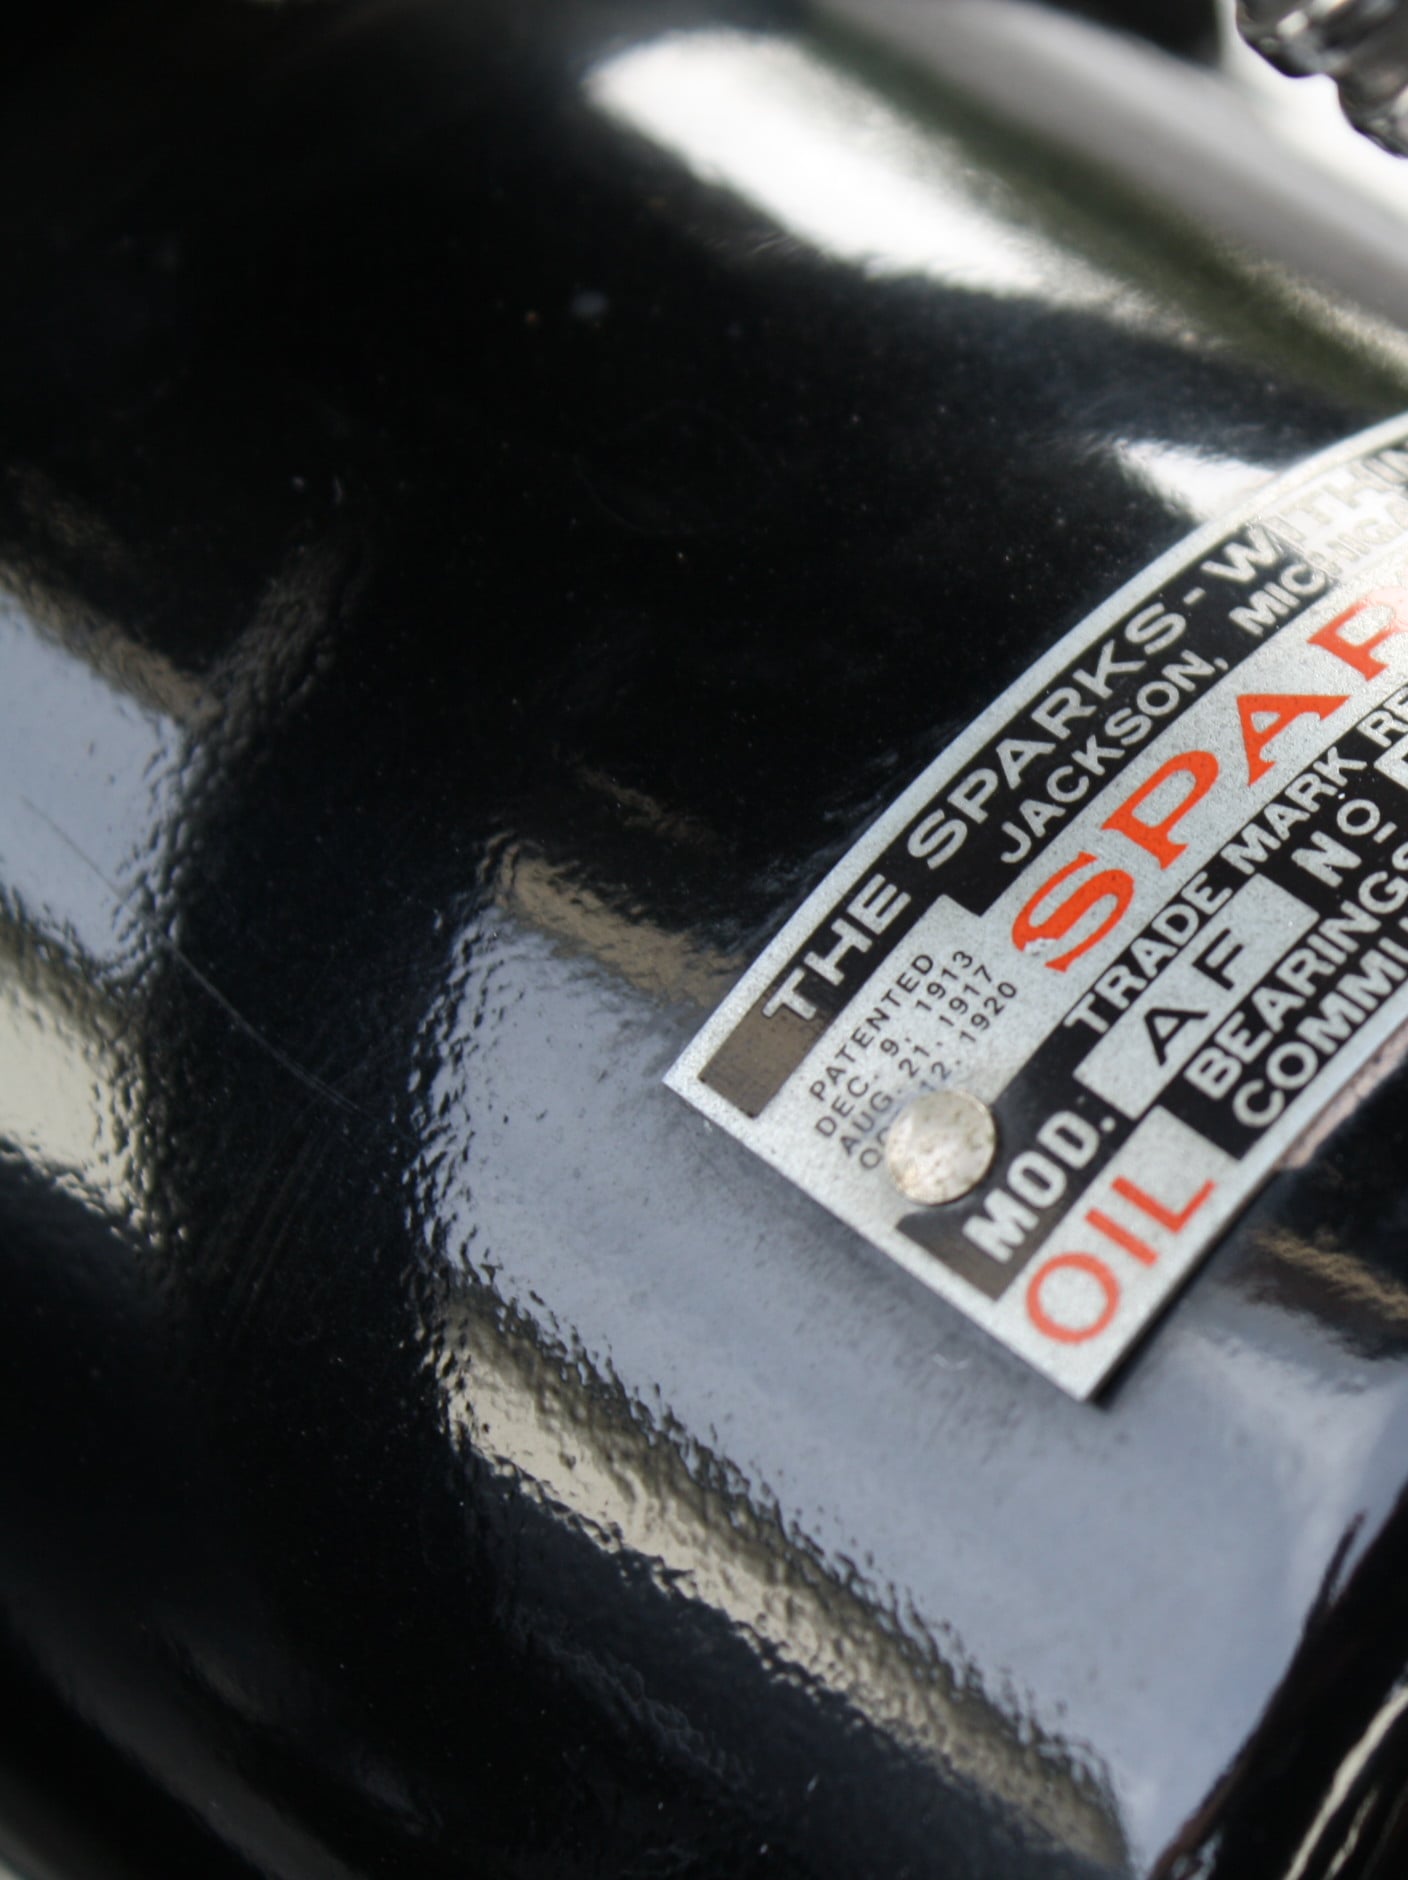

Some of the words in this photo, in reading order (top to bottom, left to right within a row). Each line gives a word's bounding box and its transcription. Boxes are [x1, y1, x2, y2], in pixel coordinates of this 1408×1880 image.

[1000, 649, 1228, 863] JACKSON,
[763, 874, 911, 1021] THE
[1065, 872, 1232, 1033] TRADE
[1221, 746, 1366, 874] MARK
[809, 953, 934, 1102] PATENTED
[815, 1074, 879, 1138] DEC.
[916, 951, 973, 1011] 1913
[939, 965, 993, 1027] 1917
[960, 981, 1017, 1043] 1920
[962, 1111, 1116, 1263] MOD.
[1026, 1175, 1217, 1345] OIL
